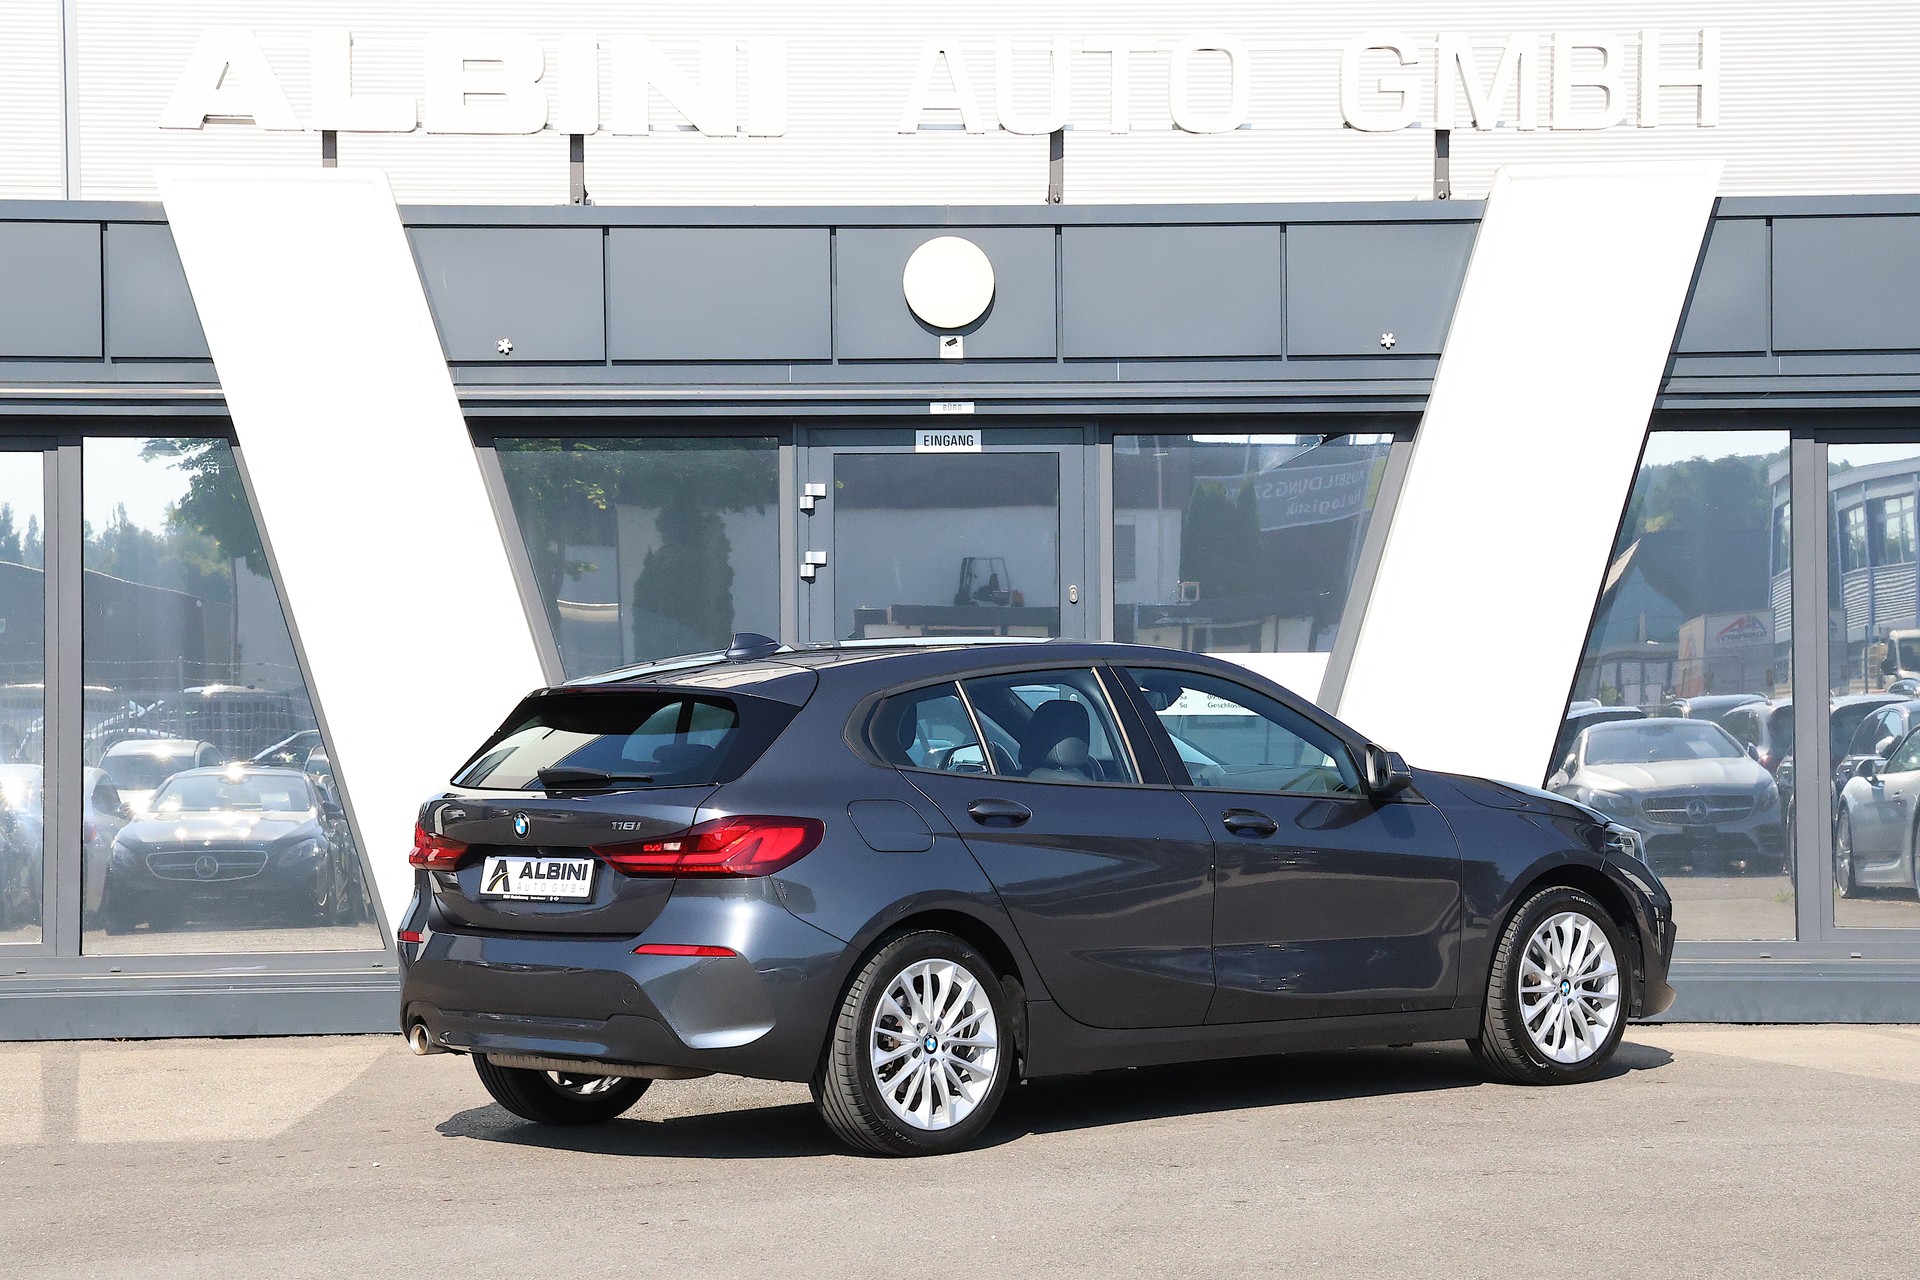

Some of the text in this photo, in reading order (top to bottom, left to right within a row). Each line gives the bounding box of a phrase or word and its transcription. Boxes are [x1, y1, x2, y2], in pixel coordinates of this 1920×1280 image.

[159, 28, 1720, 138] ALBINI AUTO GMBH
[923, 435, 974, 446] EINGANG
[519, 862, 588, 880] ALBINI
[517, 883, 585, 893] AUTO GMBH
